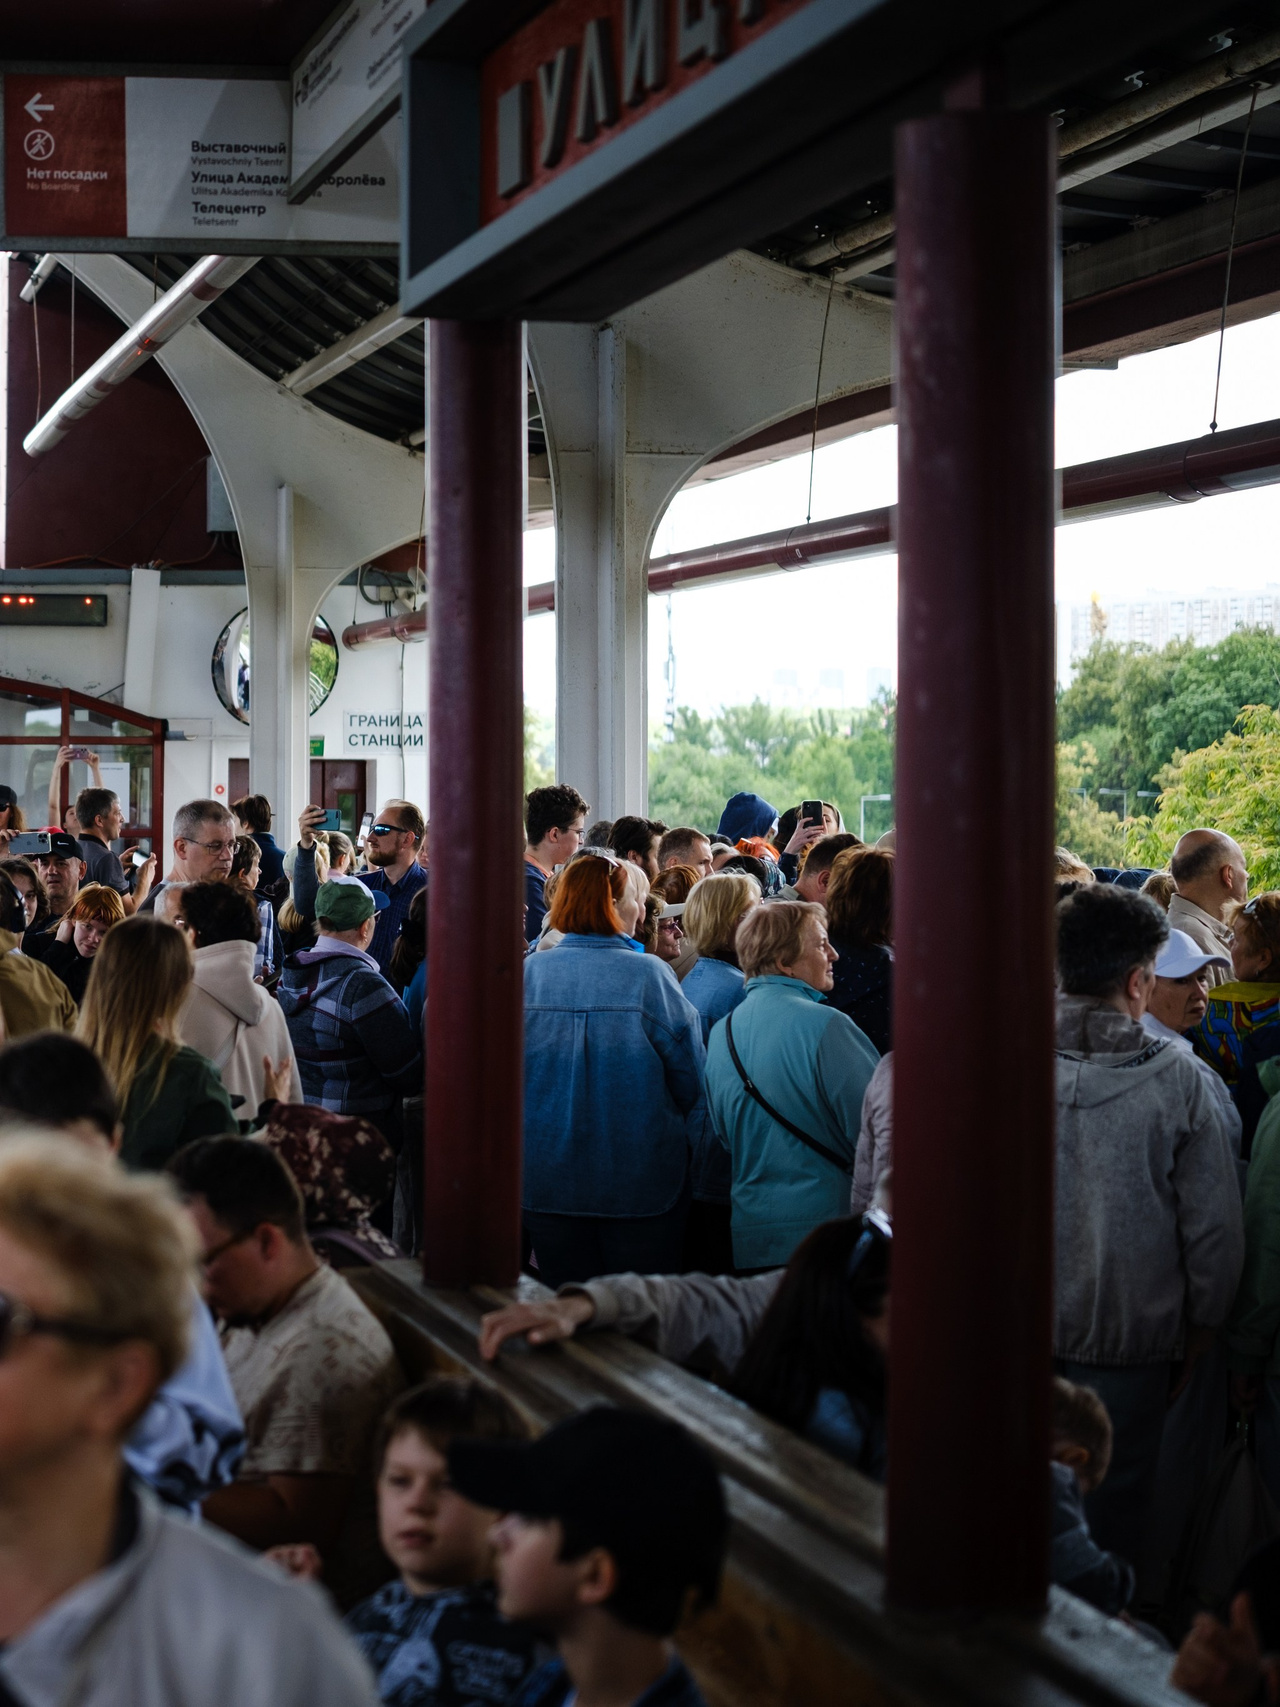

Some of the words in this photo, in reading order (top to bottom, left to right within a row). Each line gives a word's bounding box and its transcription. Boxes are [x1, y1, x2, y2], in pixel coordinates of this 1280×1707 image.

[536, 0, 766, 170] УЛИЦ
[191, 140, 287, 155] Выставочный
[255, 157, 284, 167] Tsentr
[26, 167, 51, 179] Нет
[53, 170, 108, 181] посадки
[191, 171, 234, 184] Улица
[320, 174, 386, 189] оролёва
[26, 182, 39, 190] No
[41, 182, 80, 192] Boarding
[191, 187, 219, 196] Ulitsa
[220, 187, 274, 197] Akademika
[192, 201, 267, 217] Телецентр
[192, 216, 239, 227] Teletsentr
[349, 714, 423, 729] ГРАНИЦА
[348, 733, 423, 749] СТАНЦИИ
